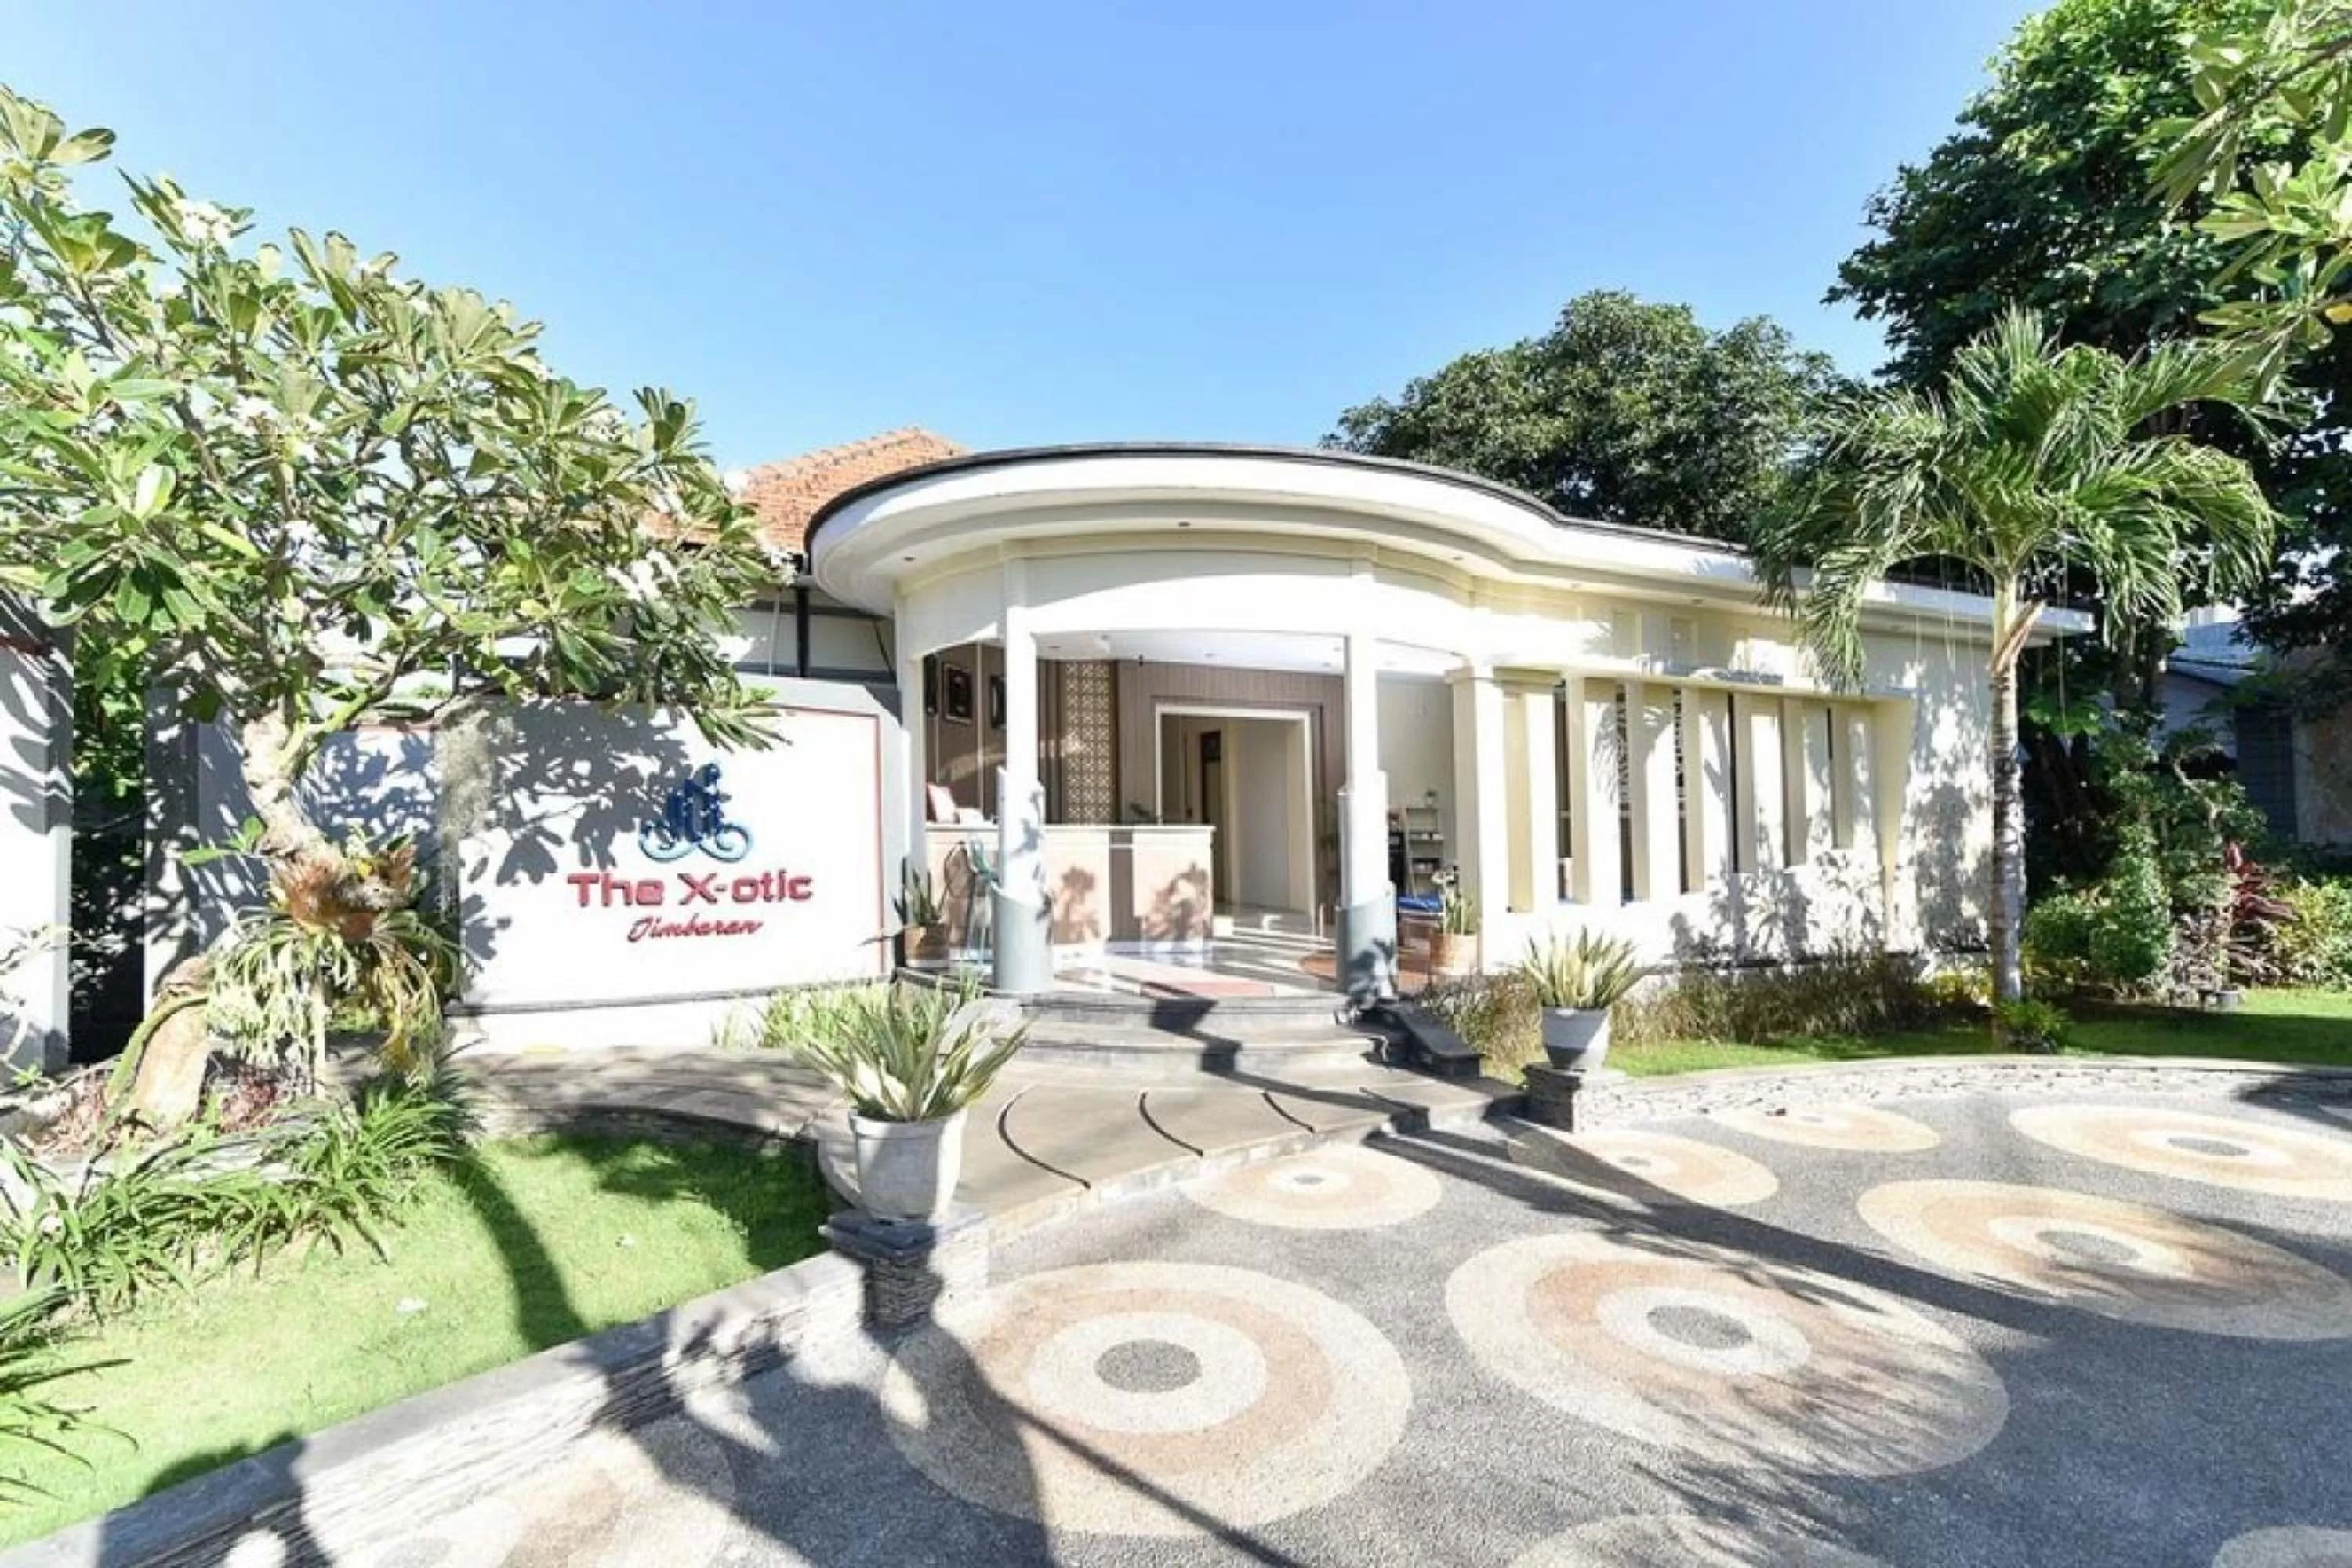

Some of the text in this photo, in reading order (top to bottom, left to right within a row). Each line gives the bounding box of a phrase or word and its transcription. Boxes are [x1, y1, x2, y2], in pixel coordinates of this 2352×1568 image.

[567, 868, 813, 907] The X-otic
[627, 913, 764, 942] Jimbaran
